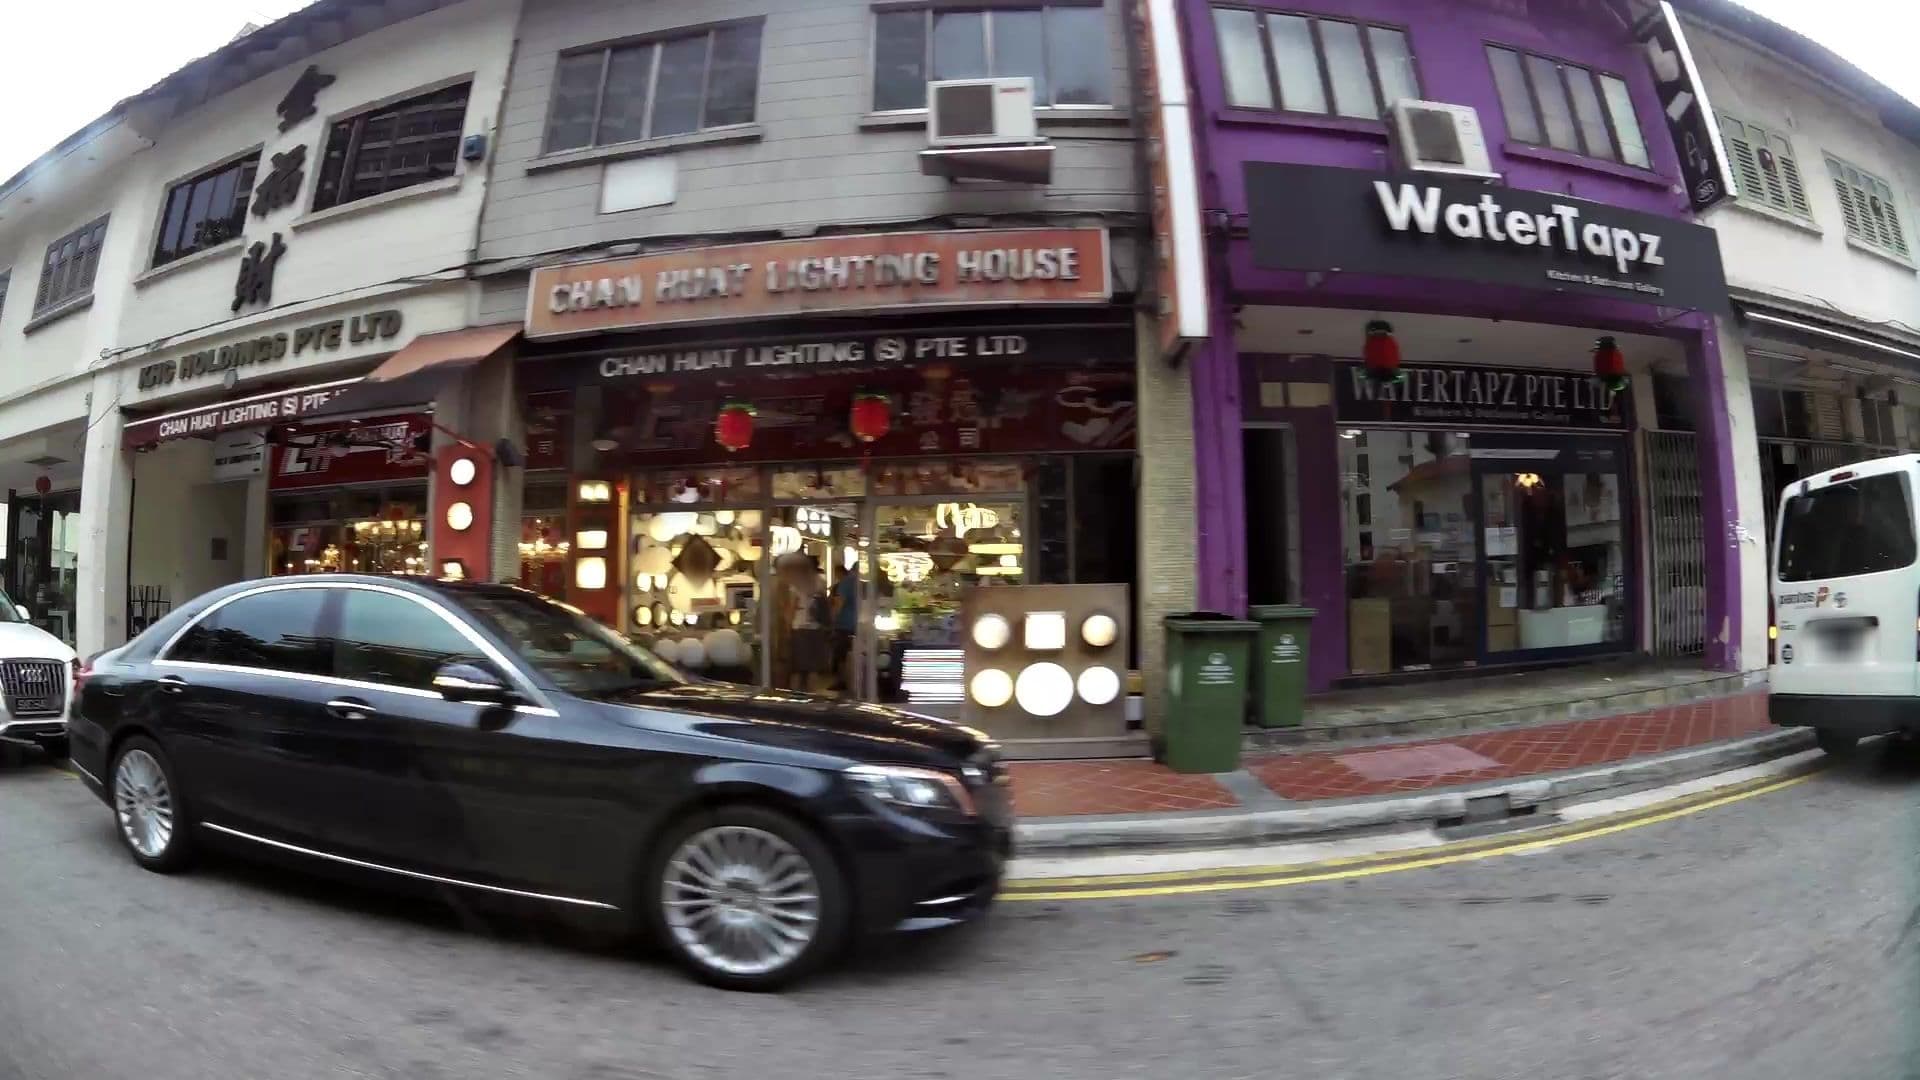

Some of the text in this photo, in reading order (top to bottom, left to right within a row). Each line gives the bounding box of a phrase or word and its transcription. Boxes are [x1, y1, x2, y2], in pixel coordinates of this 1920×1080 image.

[1373, 180, 1664, 273] WaterTapz
[550, 248, 1080, 313] CHAN HUAT LIGHTING HOUSE
[179, 332, 288, 380] HOLDINGS
[294, 319, 343, 353] PTE
[349, 310, 403, 344] LTD
[600, 335, 1028, 377] CHAN HUAT LIGHTING (S) PTE LTD
[159, 420, 187, 437] CHAN
[190, 412, 220, 431] HUAT
[222, 401, 278, 425] LIGHTING
[282, 396, 298, 416] (S)
[1526, 374, 1567, 408] PTE
